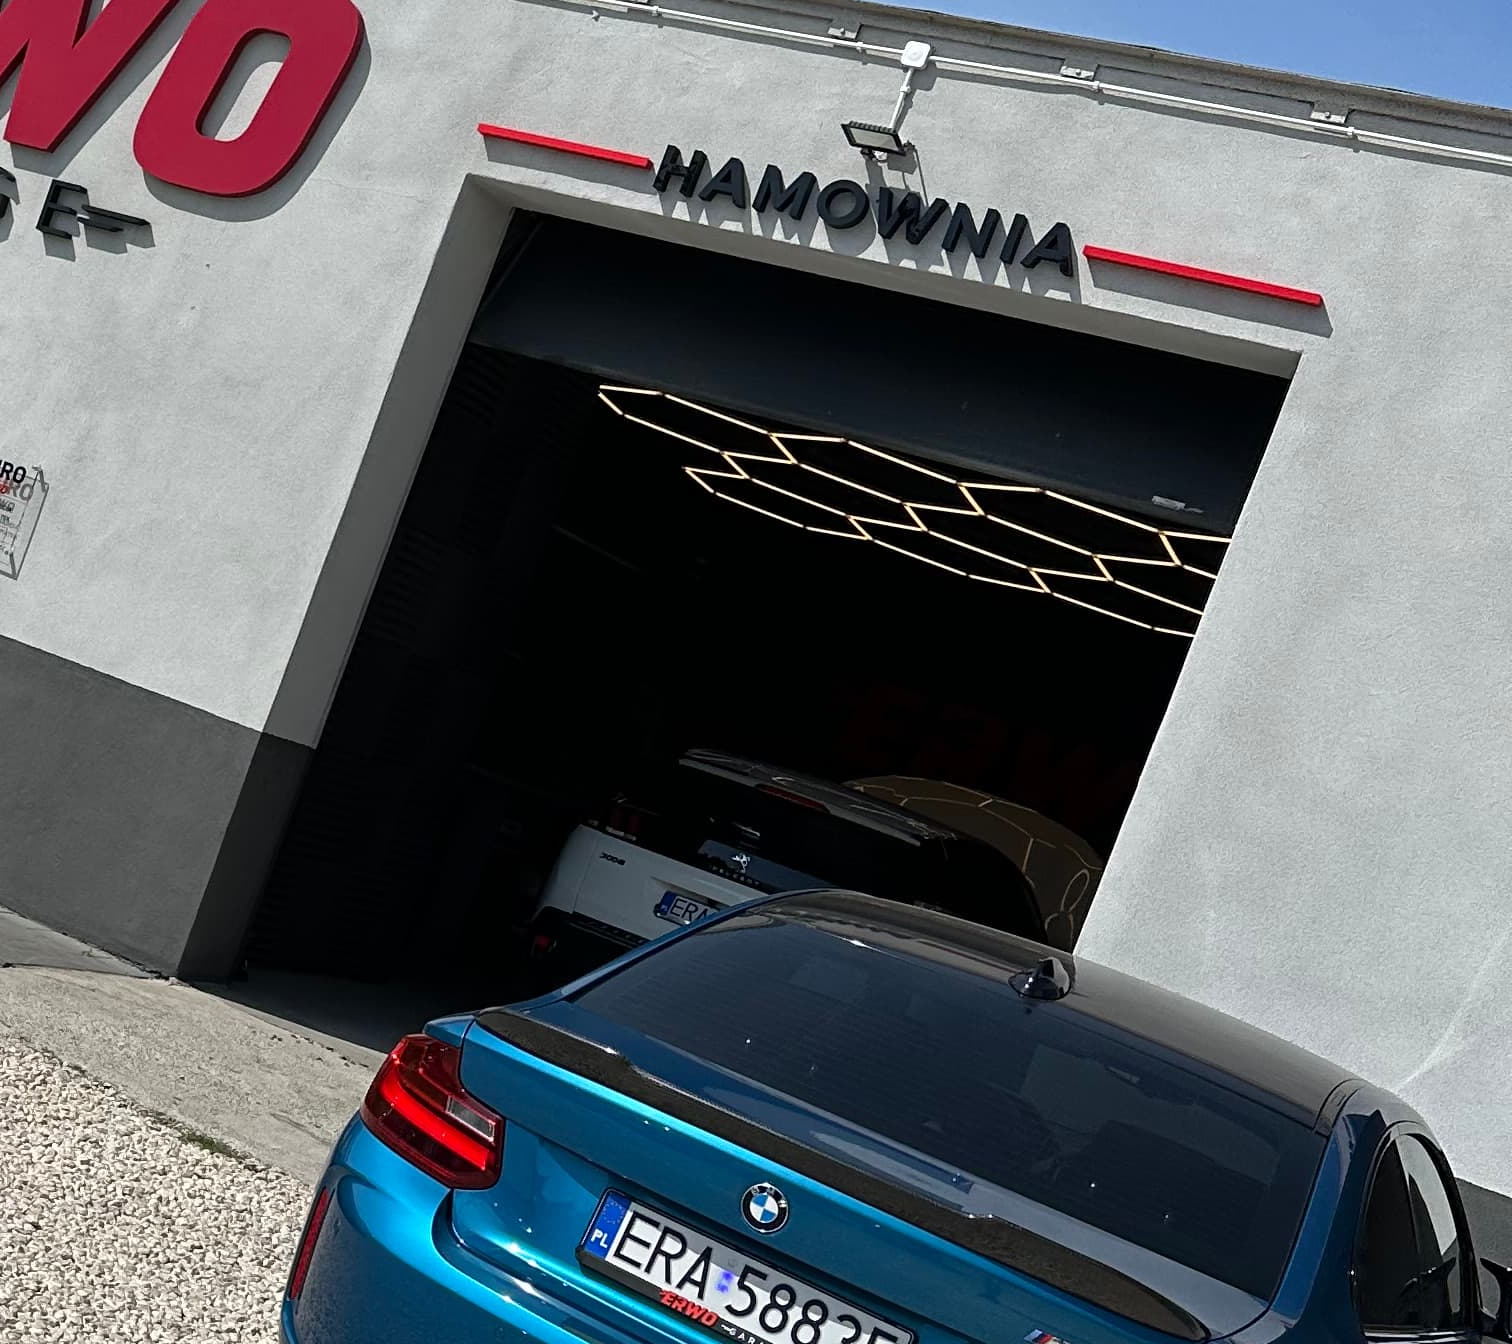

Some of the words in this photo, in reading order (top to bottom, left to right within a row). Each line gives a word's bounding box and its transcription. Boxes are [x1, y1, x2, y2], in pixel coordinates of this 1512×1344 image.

[653, 144, 1074, 277] HAMOWNIA
[590, 1229, 609, 1249] PL
[612, 1210, 714, 1301] ERA
[661, 1289, 719, 1327] ERWO
